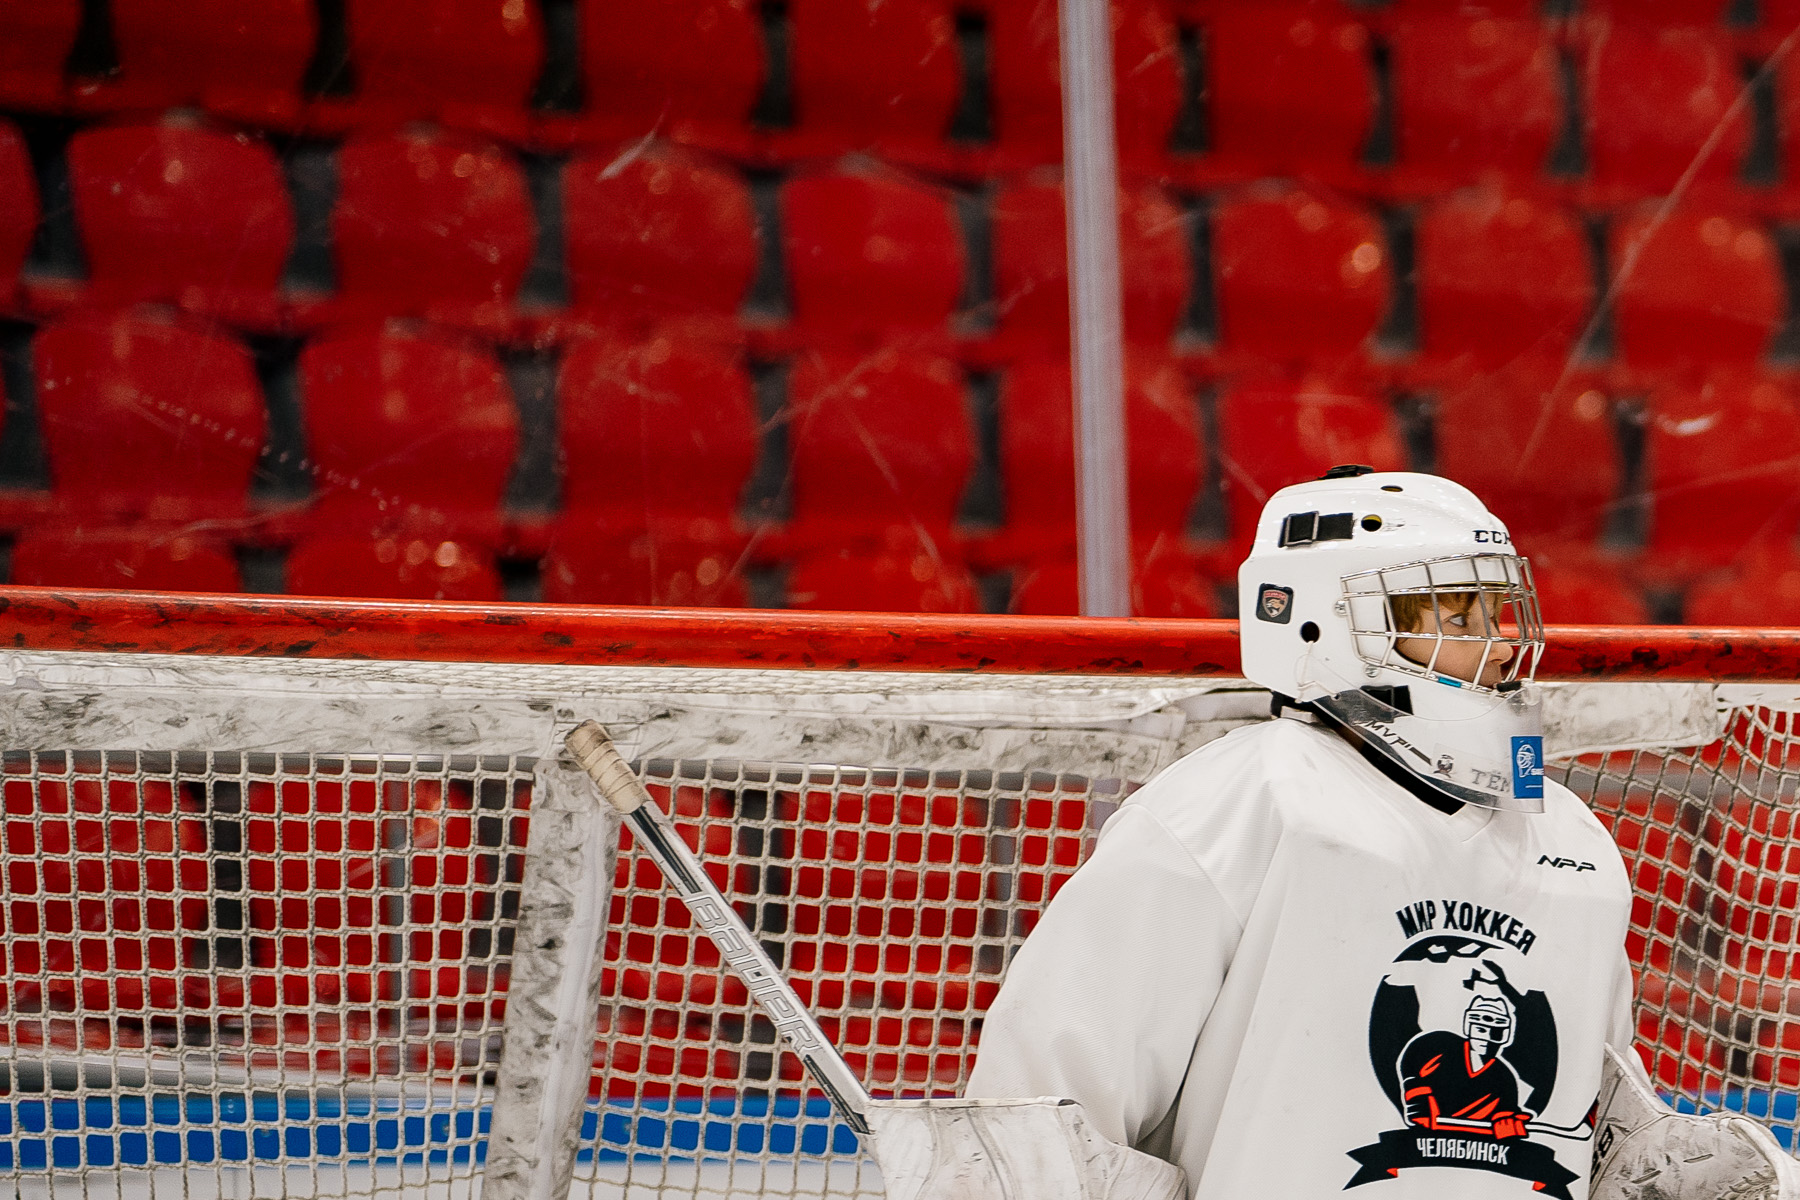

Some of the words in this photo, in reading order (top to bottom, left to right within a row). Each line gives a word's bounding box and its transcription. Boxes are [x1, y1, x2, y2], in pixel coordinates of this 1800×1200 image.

[1536, 854, 1597, 873] NPP
[1395, 899, 1437, 940] МИР
[1441, 899, 1537, 957] ХОККЕЯ
[1416, 1137, 1510, 1166] ЧЕЛЯБИНСК
